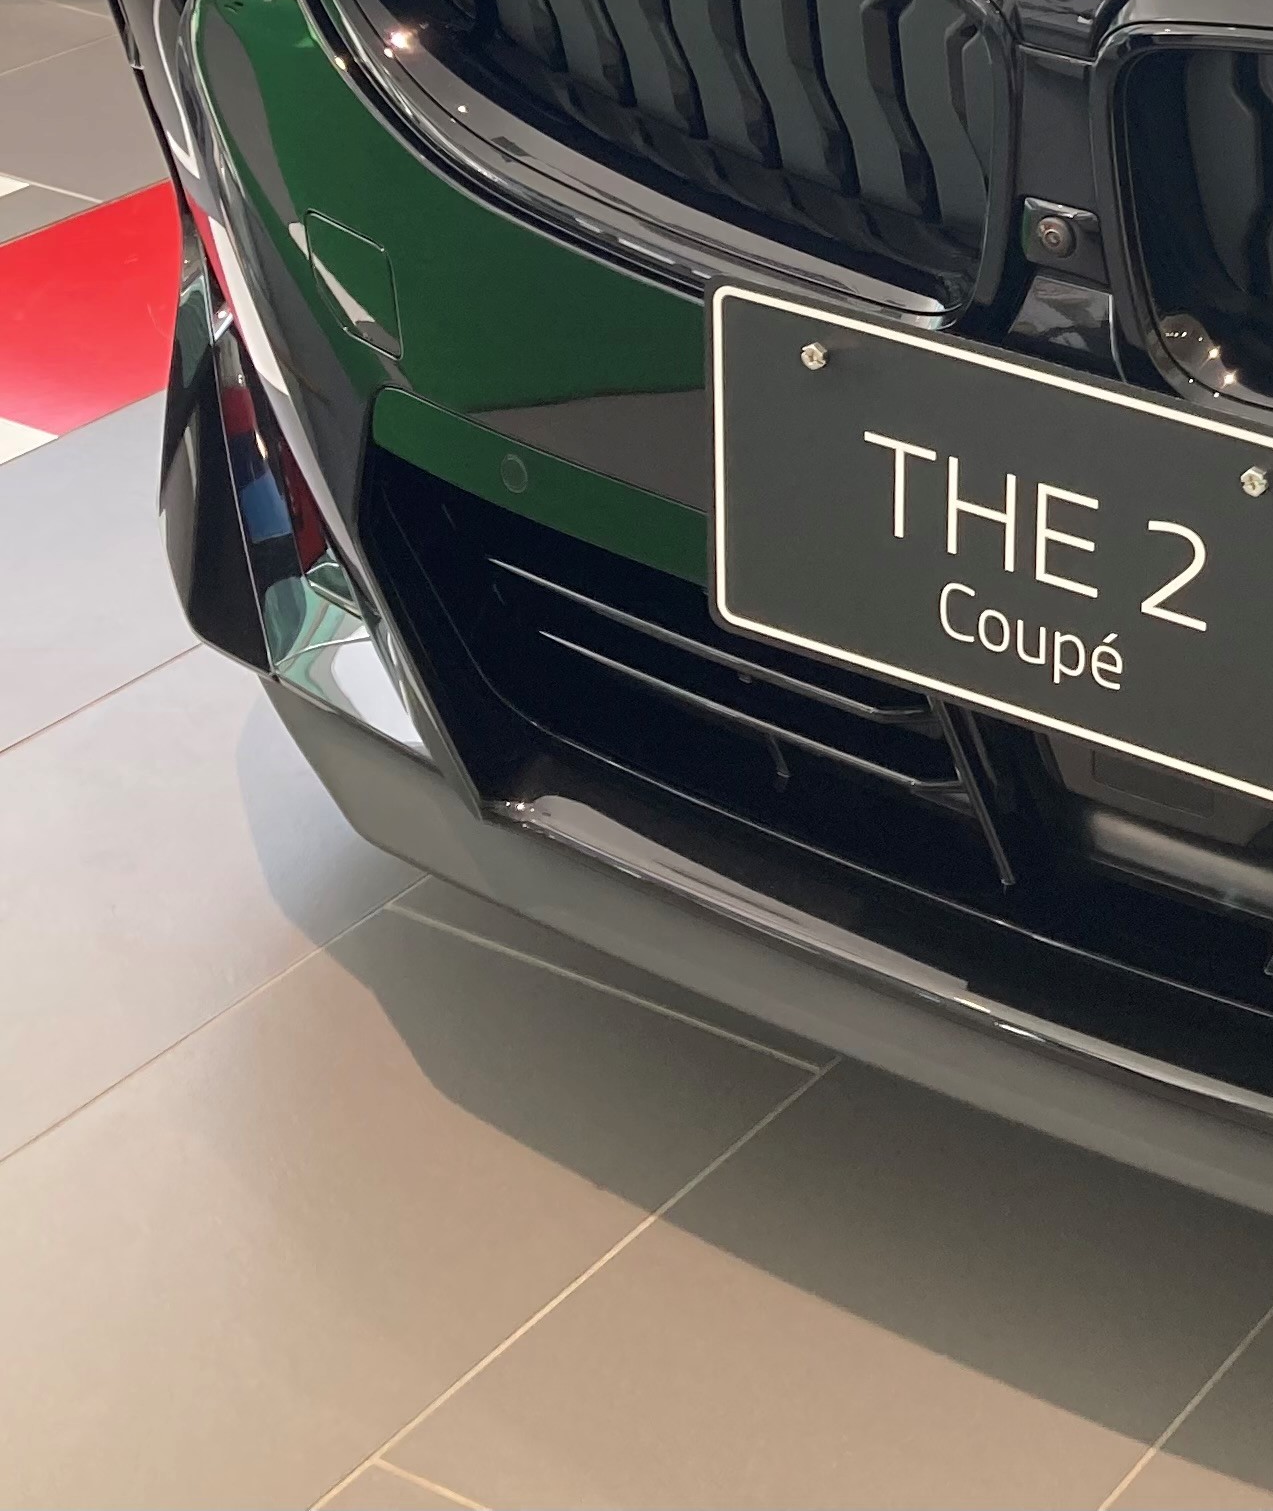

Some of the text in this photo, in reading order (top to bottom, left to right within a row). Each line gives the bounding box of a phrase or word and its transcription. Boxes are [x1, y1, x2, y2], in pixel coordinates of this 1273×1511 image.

[864, 431, 1206, 631] THE 2
[940, 582, 1123, 690] Coupé
